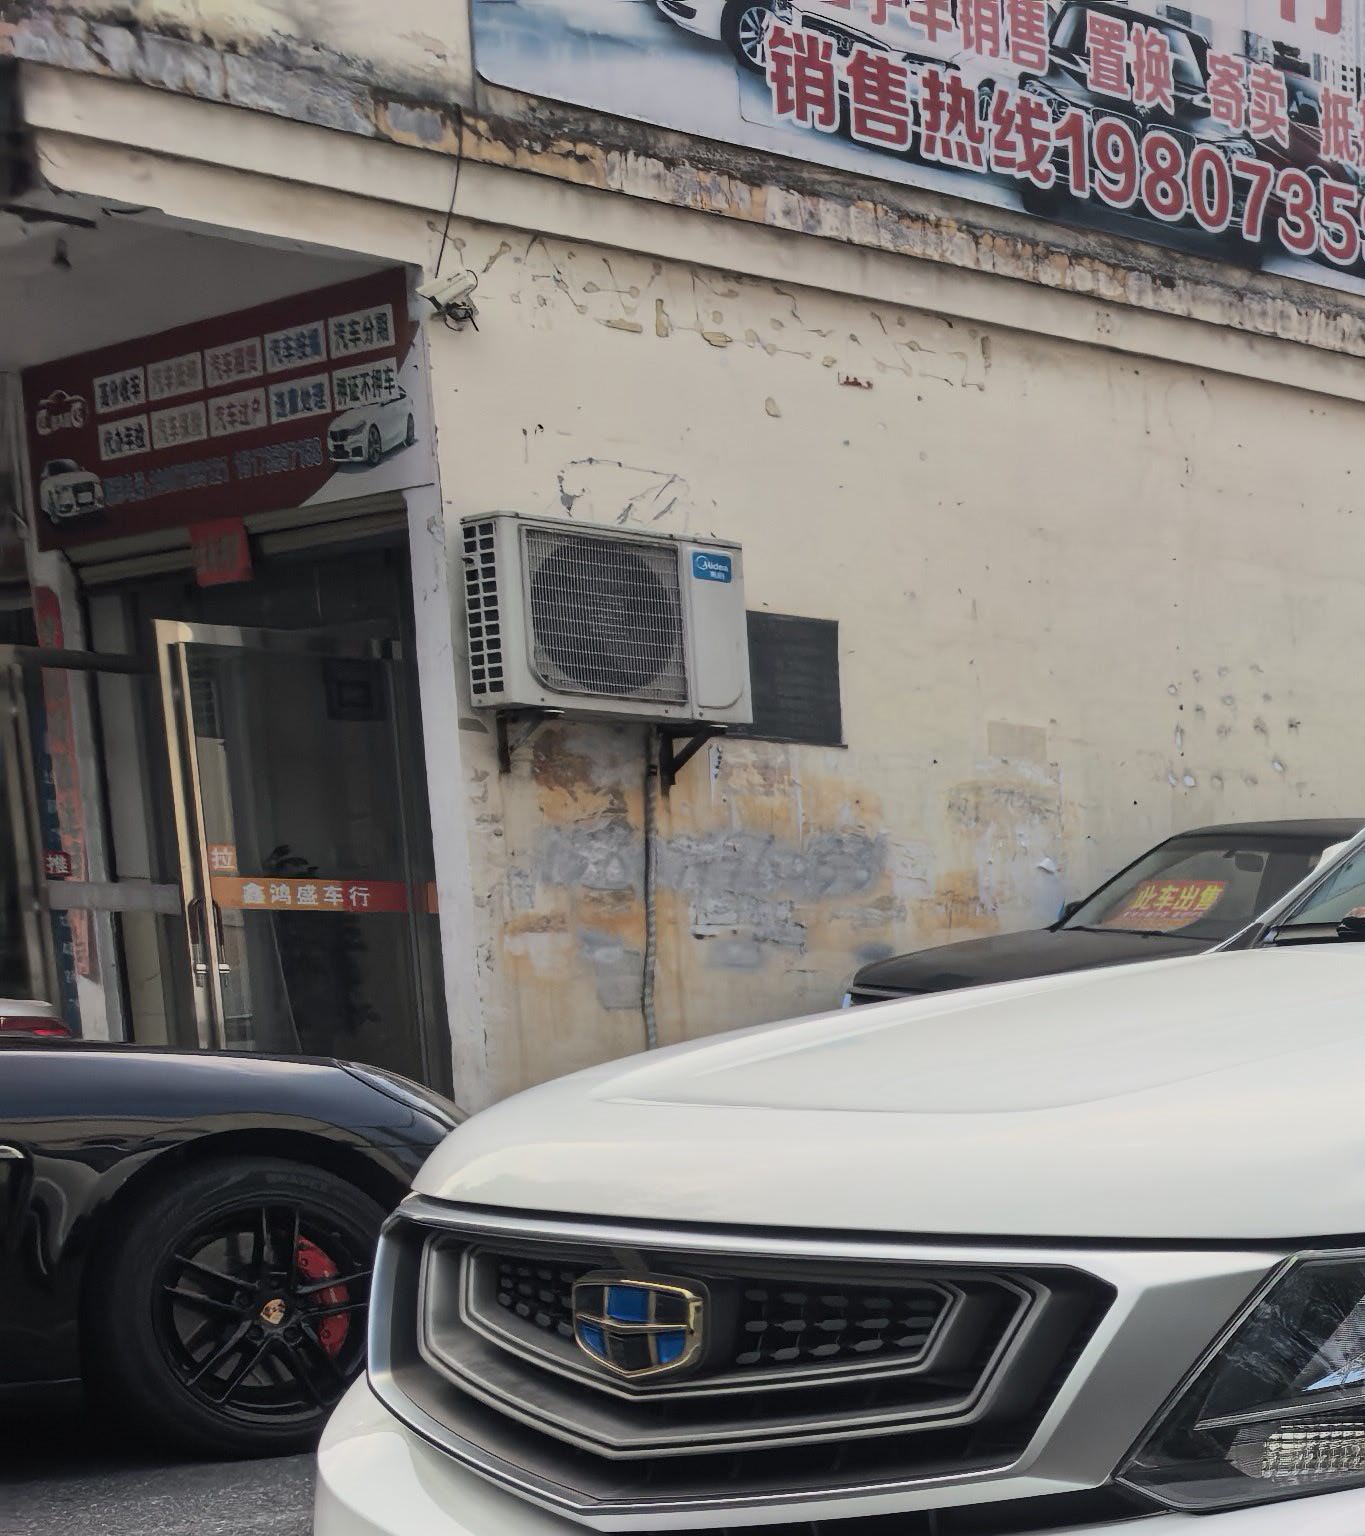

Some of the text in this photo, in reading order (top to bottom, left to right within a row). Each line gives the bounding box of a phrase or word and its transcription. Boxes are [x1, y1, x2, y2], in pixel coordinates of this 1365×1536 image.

[820, 0, 1047, 70] 车销售
[1088, 14, 1173, 111] 置换
[1208, 54, 1288, 145] 寄卖
[211, 847, 234, 870] 拉
[242, 881, 370, 907] 鑫鸿盛车行
[1131, 884, 1223, 909] 此车出售
